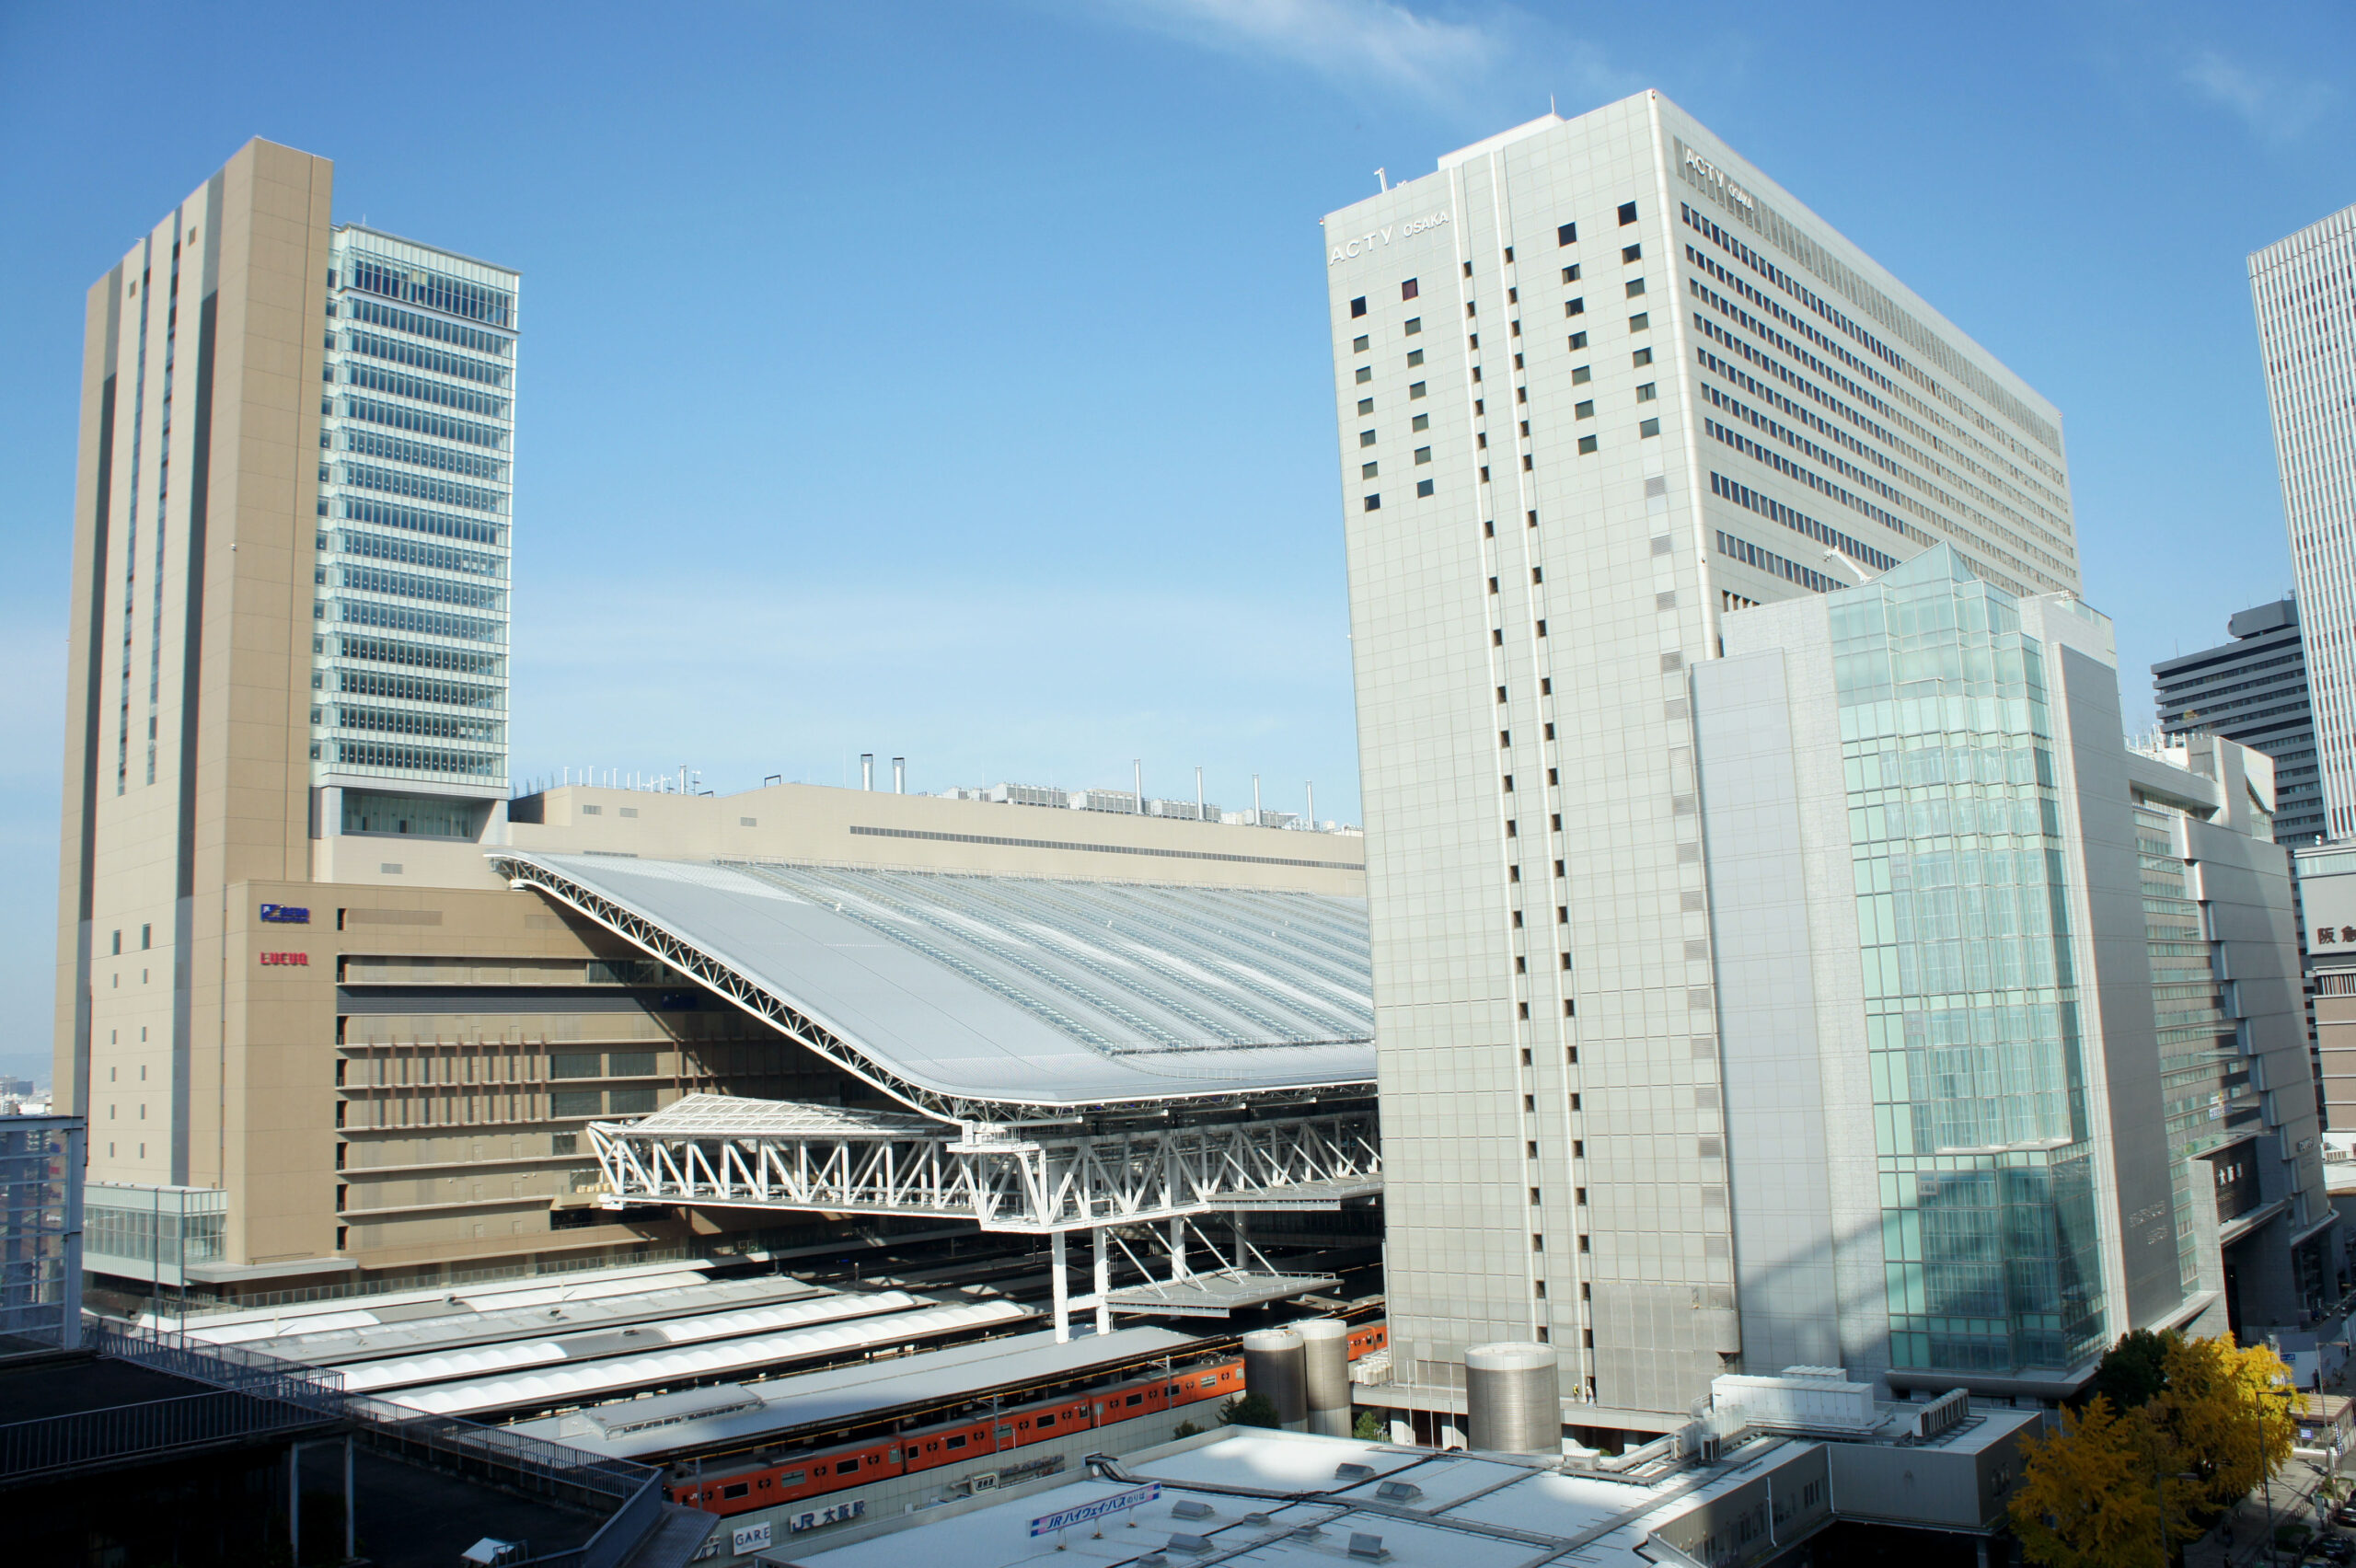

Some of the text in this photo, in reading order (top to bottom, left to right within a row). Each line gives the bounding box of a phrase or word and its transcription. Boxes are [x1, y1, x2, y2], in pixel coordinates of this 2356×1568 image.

[1686, 148, 1724, 189] ACTY
[1329, 211, 1449, 266] ACTY OSAKA
[735, 1526, 770, 1546] GARE
[792, 1512, 815, 1531] JR
